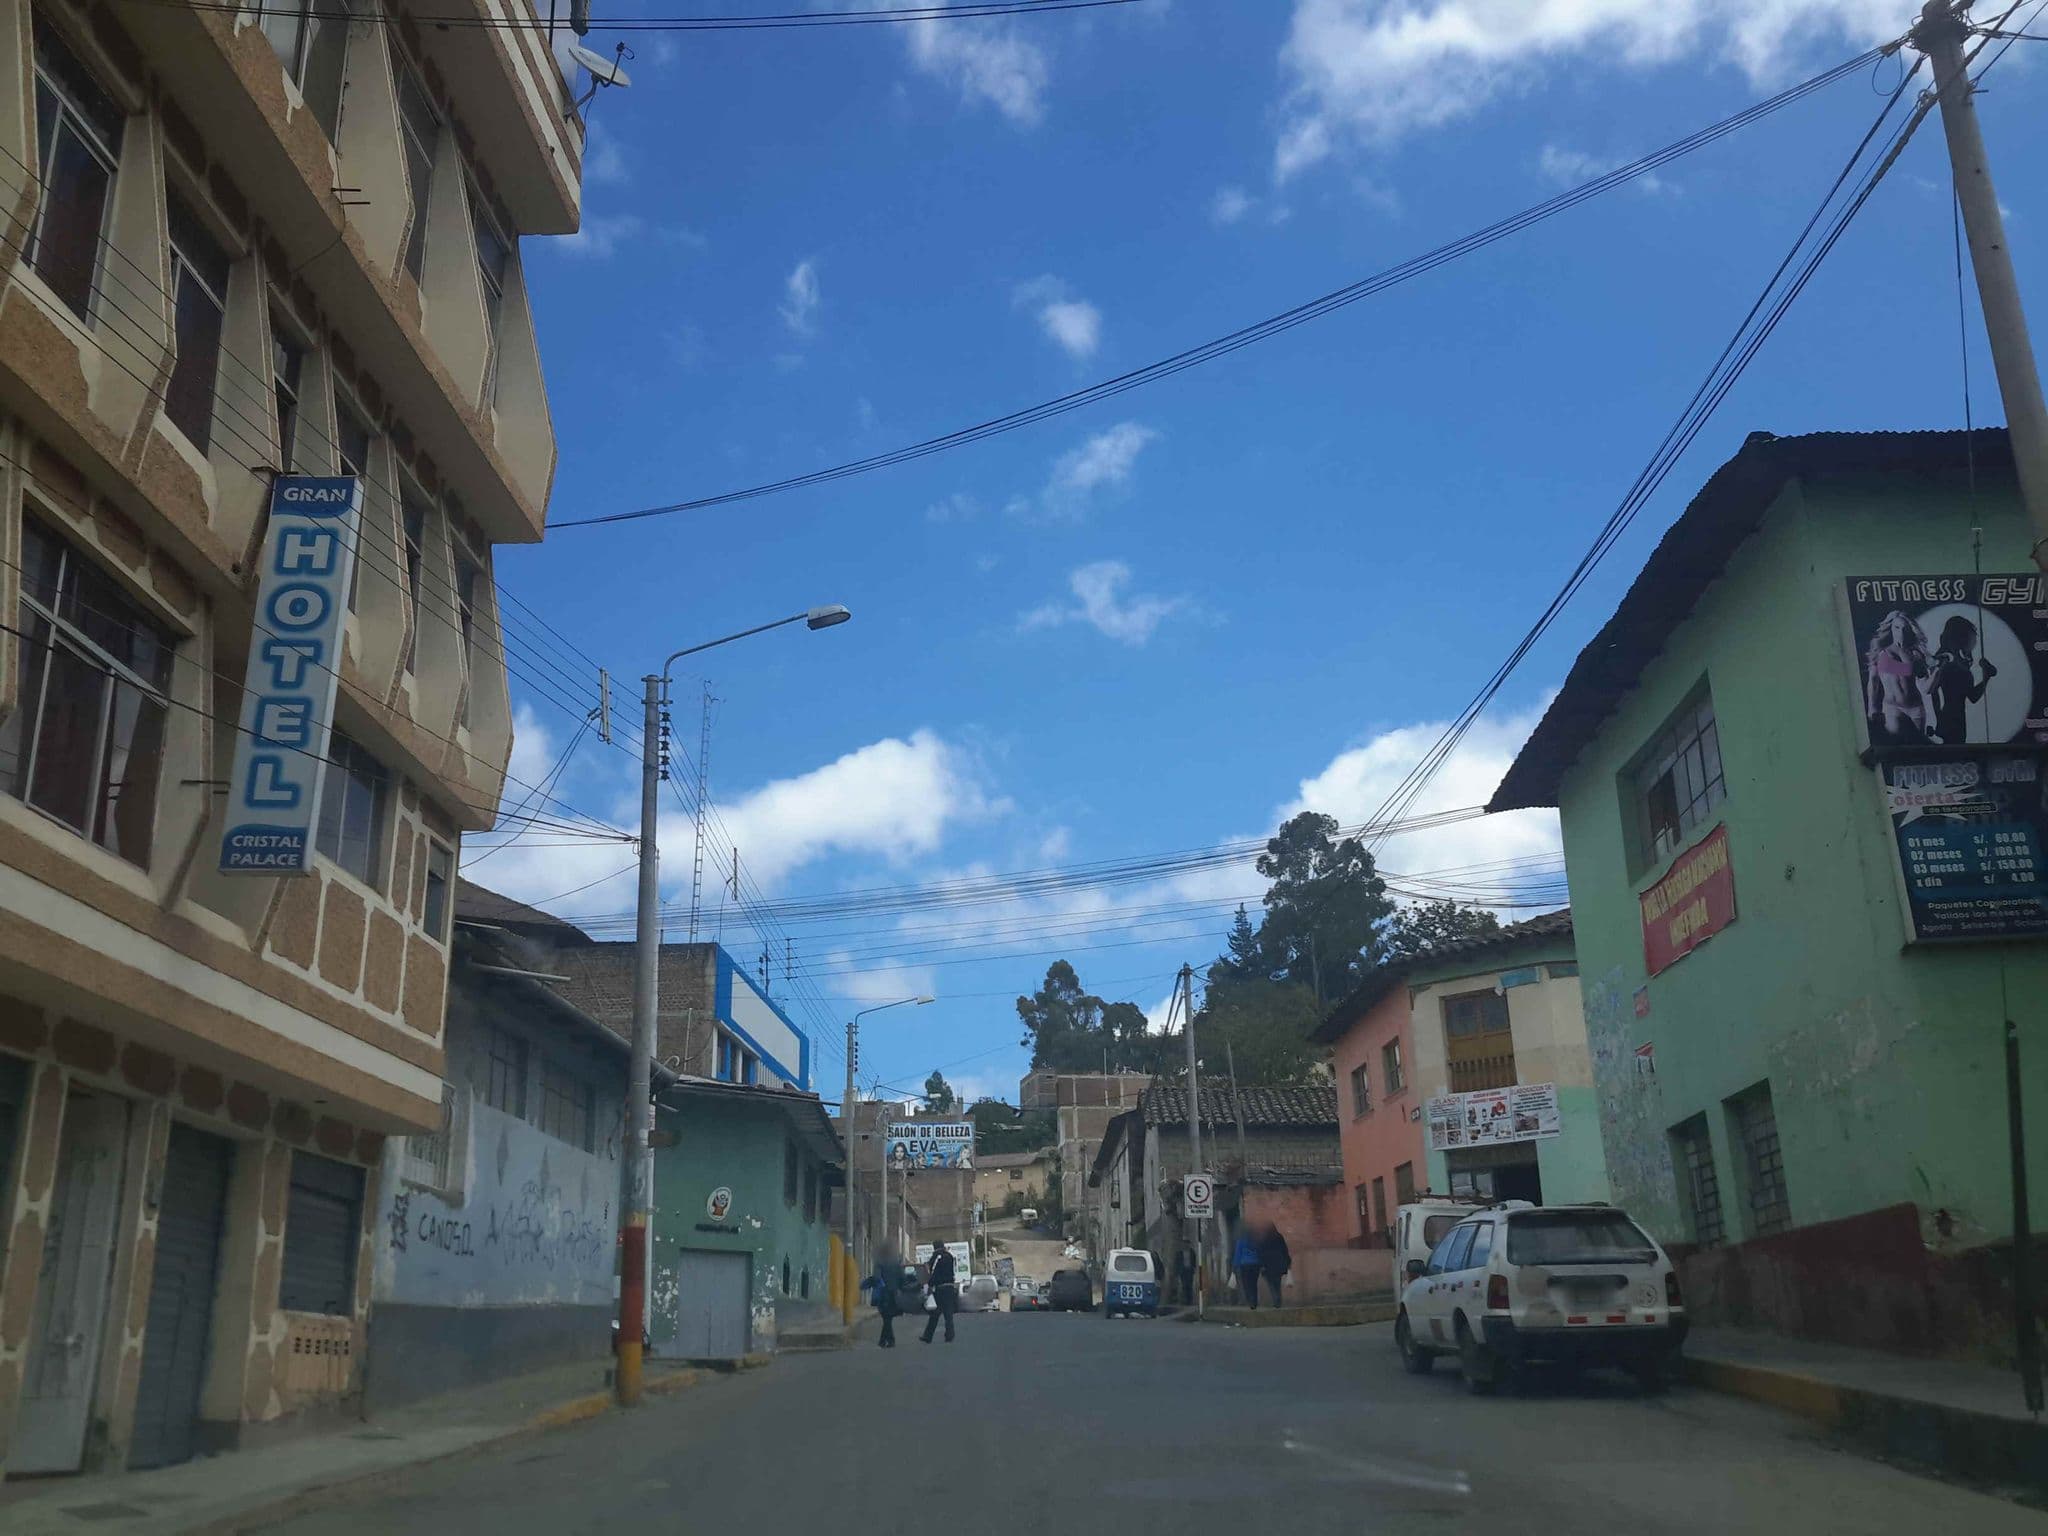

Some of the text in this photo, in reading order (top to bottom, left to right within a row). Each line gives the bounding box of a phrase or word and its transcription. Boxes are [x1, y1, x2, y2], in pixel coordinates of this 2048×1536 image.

[283, 487, 347, 502] GRAN
[1856, 579, 1966, 602] FITNESS
[252, 533, 334, 802] HOTEL
[1894, 762, 1979, 786] FITNESS
[231, 834, 301, 848] CRISTAL
[1923, 838, 1945, 847] mes
[230, 853, 299, 867] PALACE
[1911, 850, 1924, 860] 02
[1927, 850, 1962, 860] meses
[1913, 863, 1927, 873] 03
[1930, 863, 1965, 872] meses
[888, 1124, 970, 1138] SALÓN DE BELLEZA
[909, 1140, 939, 1152] EVA
[1194, 1186, 1202, 1198] E
[1121, 1286, 1142, 1298] 820
